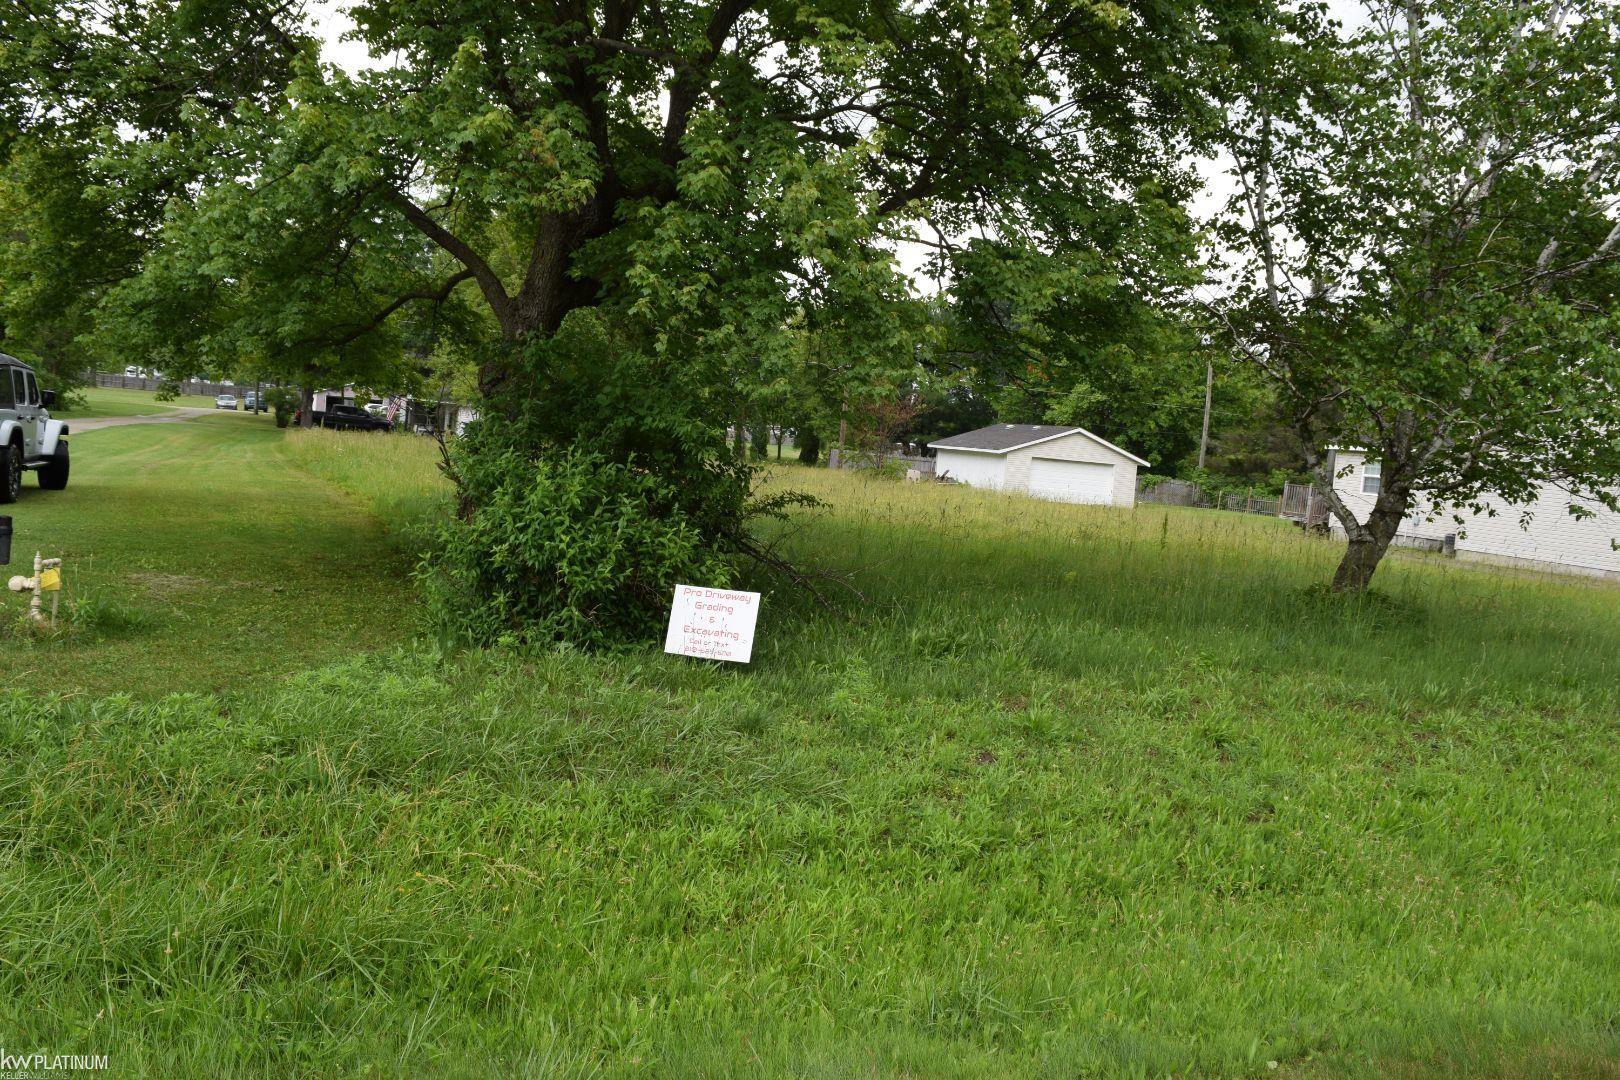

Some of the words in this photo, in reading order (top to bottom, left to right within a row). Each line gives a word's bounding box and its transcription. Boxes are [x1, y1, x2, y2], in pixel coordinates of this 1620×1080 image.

[683, 587, 703, 598] Pro
[705, 589, 752, 604] Driveway
[694, 601, 734, 615] Grading
[683, 624, 740, 641] Excavating
